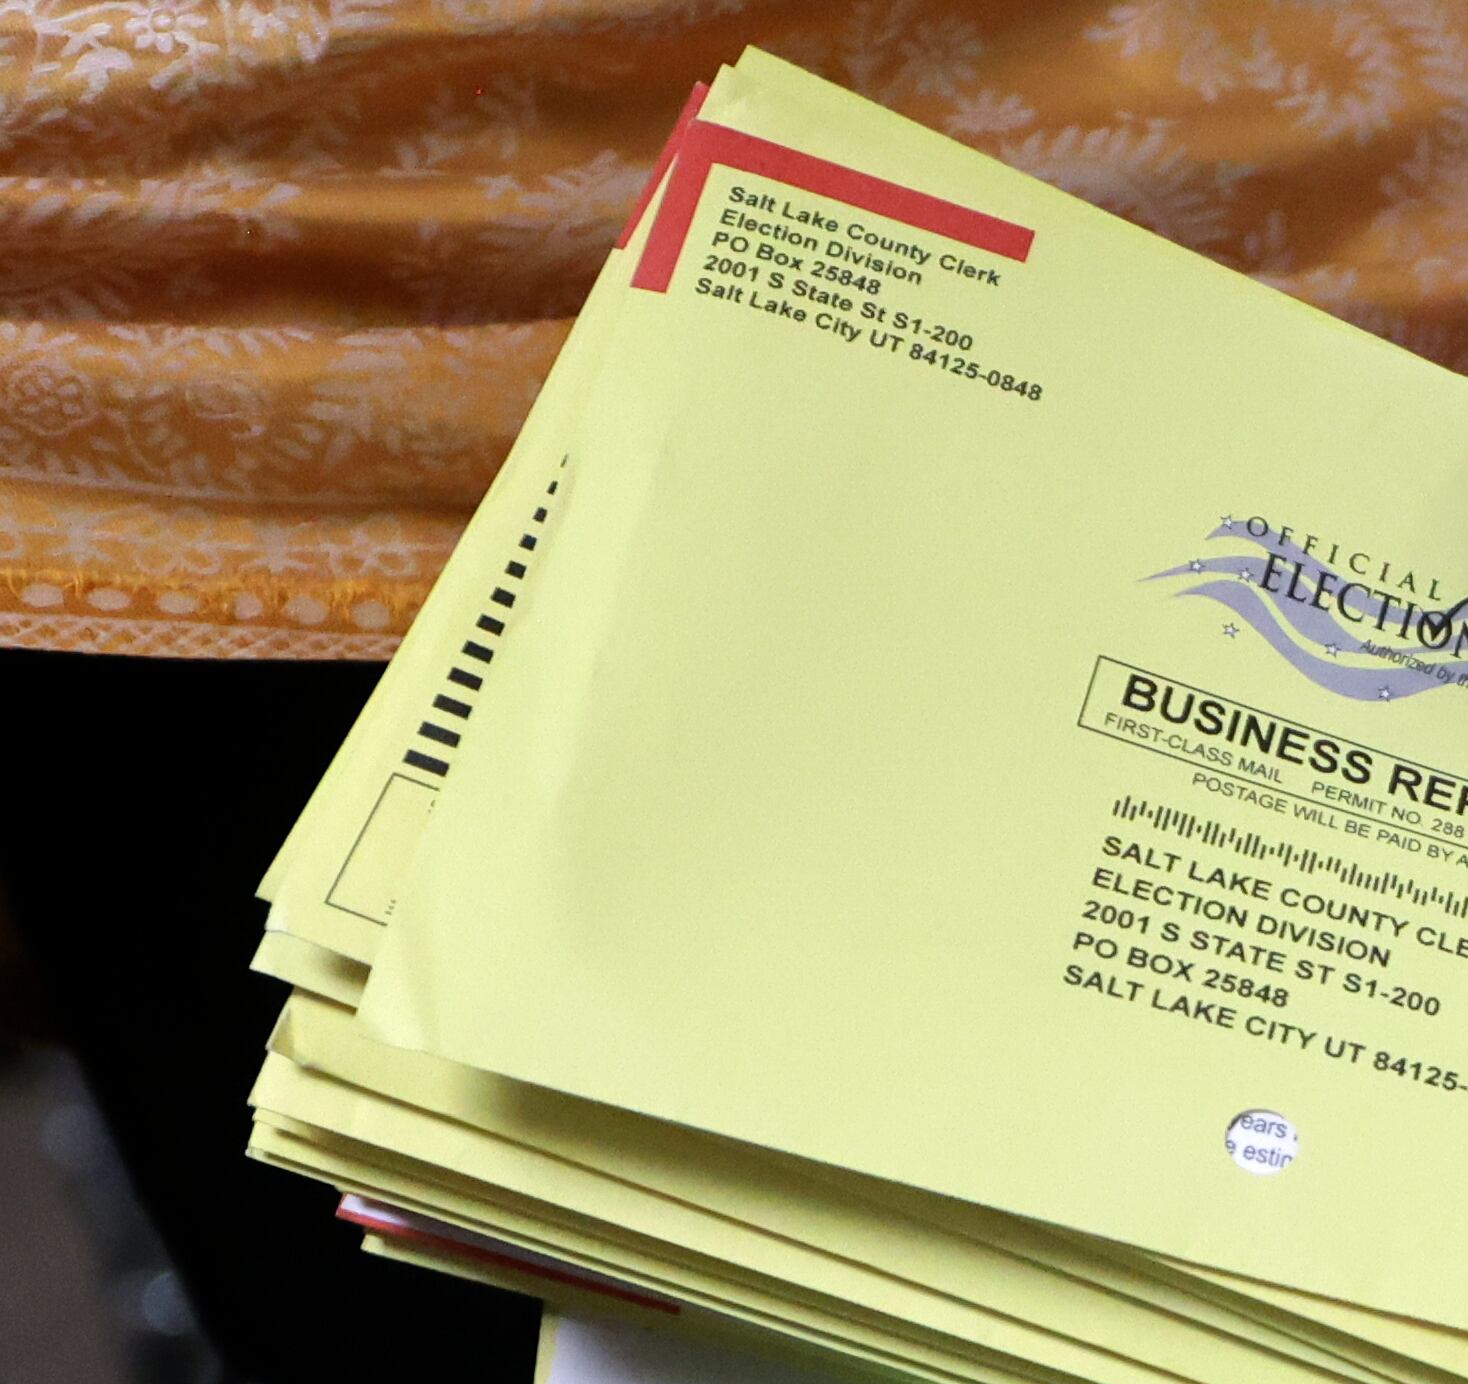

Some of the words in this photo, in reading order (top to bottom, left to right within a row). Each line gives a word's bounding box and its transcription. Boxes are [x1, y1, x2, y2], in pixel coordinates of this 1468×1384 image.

[712, 232, 749, 252] PO
[756, 243, 803, 271] Box
[810, 261, 881, 295] 25848
[720, 208, 818, 251] Election
[825, 241, 922, 285] Division
[729, 187, 776, 213] Salt
[782, 202, 838, 232] Lake
[847, 224, 931, 265] County
[939, 255, 1000, 286] Clerk
[695, 278, 743, 303] Salt
[749, 292, 807, 322] Lake
[815, 313, 862, 342] City
[870, 329, 904, 352] UT
[909, 343, 1042, 401] 84125-0848
[703, 255, 759, 282] 2001
[768, 272, 784, 289] S
[792, 280, 853, 311] State
[860, 302, 886, 323] St
[893, 312, 973, 351] S1-200
[1246, 516, 1441, 602] OFFICIAL
[1361, 639, 1436, 676] Authorized
[1436, 664, 1456, 684] by
[1104, 712, 1233, 766] FIRST-CLASS
[1235, 757, 1283, 784] MAIL
[1311, 781, 1387, 814] PERMIT
[1430, 818, 1464, 839] 288
[1122, 674, 1373, 784] BUSINESS
[1192, 772, 1288, 814] POSTAGE
[1294, 805, 1338, 829] WILL
[1344, 820, 1371, 838] BE
[1376, 829, 1422, 852] PAID
[1427, 844, 1454, 862] BY
[1092, 867, 1248, 928] ELECTION
[1256, 914, 1391, 968] DIVISION
[1102, 836, 1181, 873] SALT
[1187, 860, 1272, 901] LAKE
[1280, 888, 1409, 937] COUNTY
[1073, 932, 1118, 959] PO
[1127, 947, 1194, 982] BOX
[1202, 969, 1289, 1007] 25848
[1082, 900, 1150, 934] 2001
[1161, 922, 1180, 942] S
[1190, 931, 1287, 973] STATE
[1295, 960, 1336, 984] ST
[1343, 973, 1440, 1016] S1-200
[1063, 965, 1144, 1001] SALT
[1151, 989, 1237, 1028] LAKE
[1245, 1016, 1317, 1049] CITY
[1325, 1037, 1366, 1063] UT
[1235, 1113, 1288, 1138] ears
